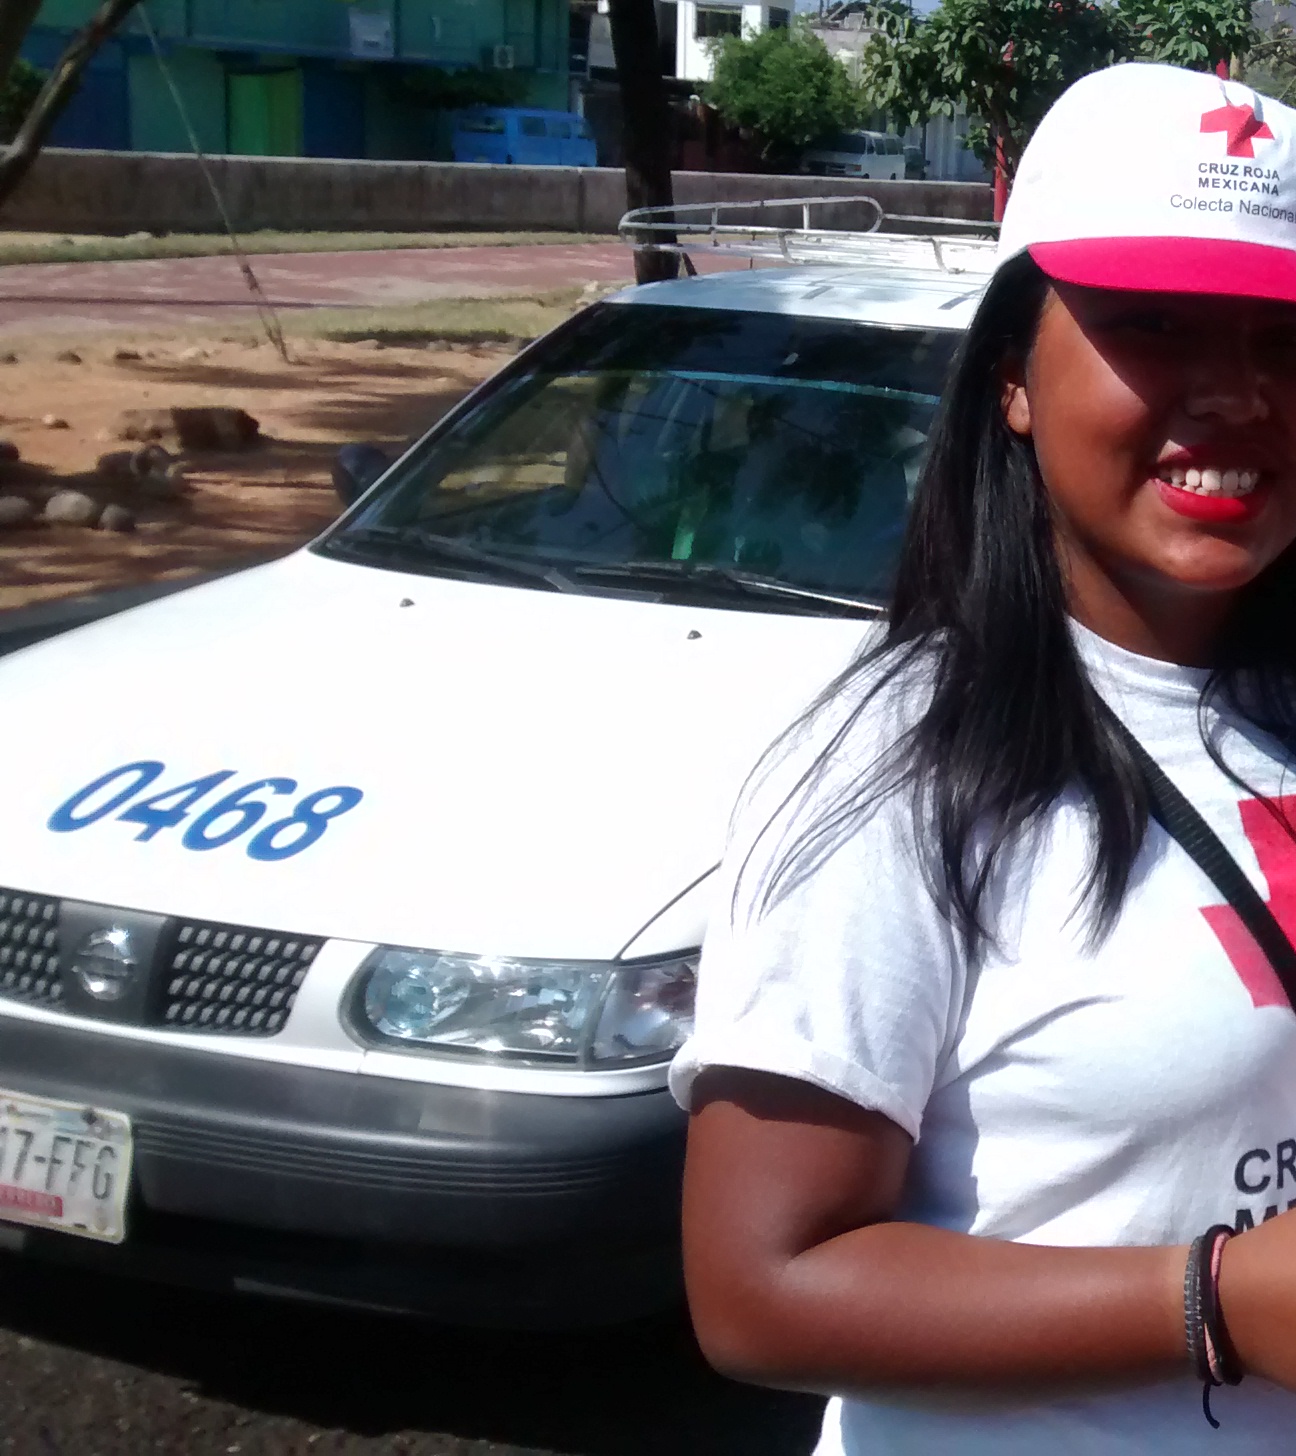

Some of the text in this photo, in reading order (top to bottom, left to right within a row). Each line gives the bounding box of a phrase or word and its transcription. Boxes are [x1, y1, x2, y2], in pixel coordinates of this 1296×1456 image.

[1198, 162, 1280, 181] CRUZ ROJA
[1198, 177, 1280, 196] MEXICANA
[1170, 194, 1233, 212] Colecta
[46, 760, 364, 862] 0468
